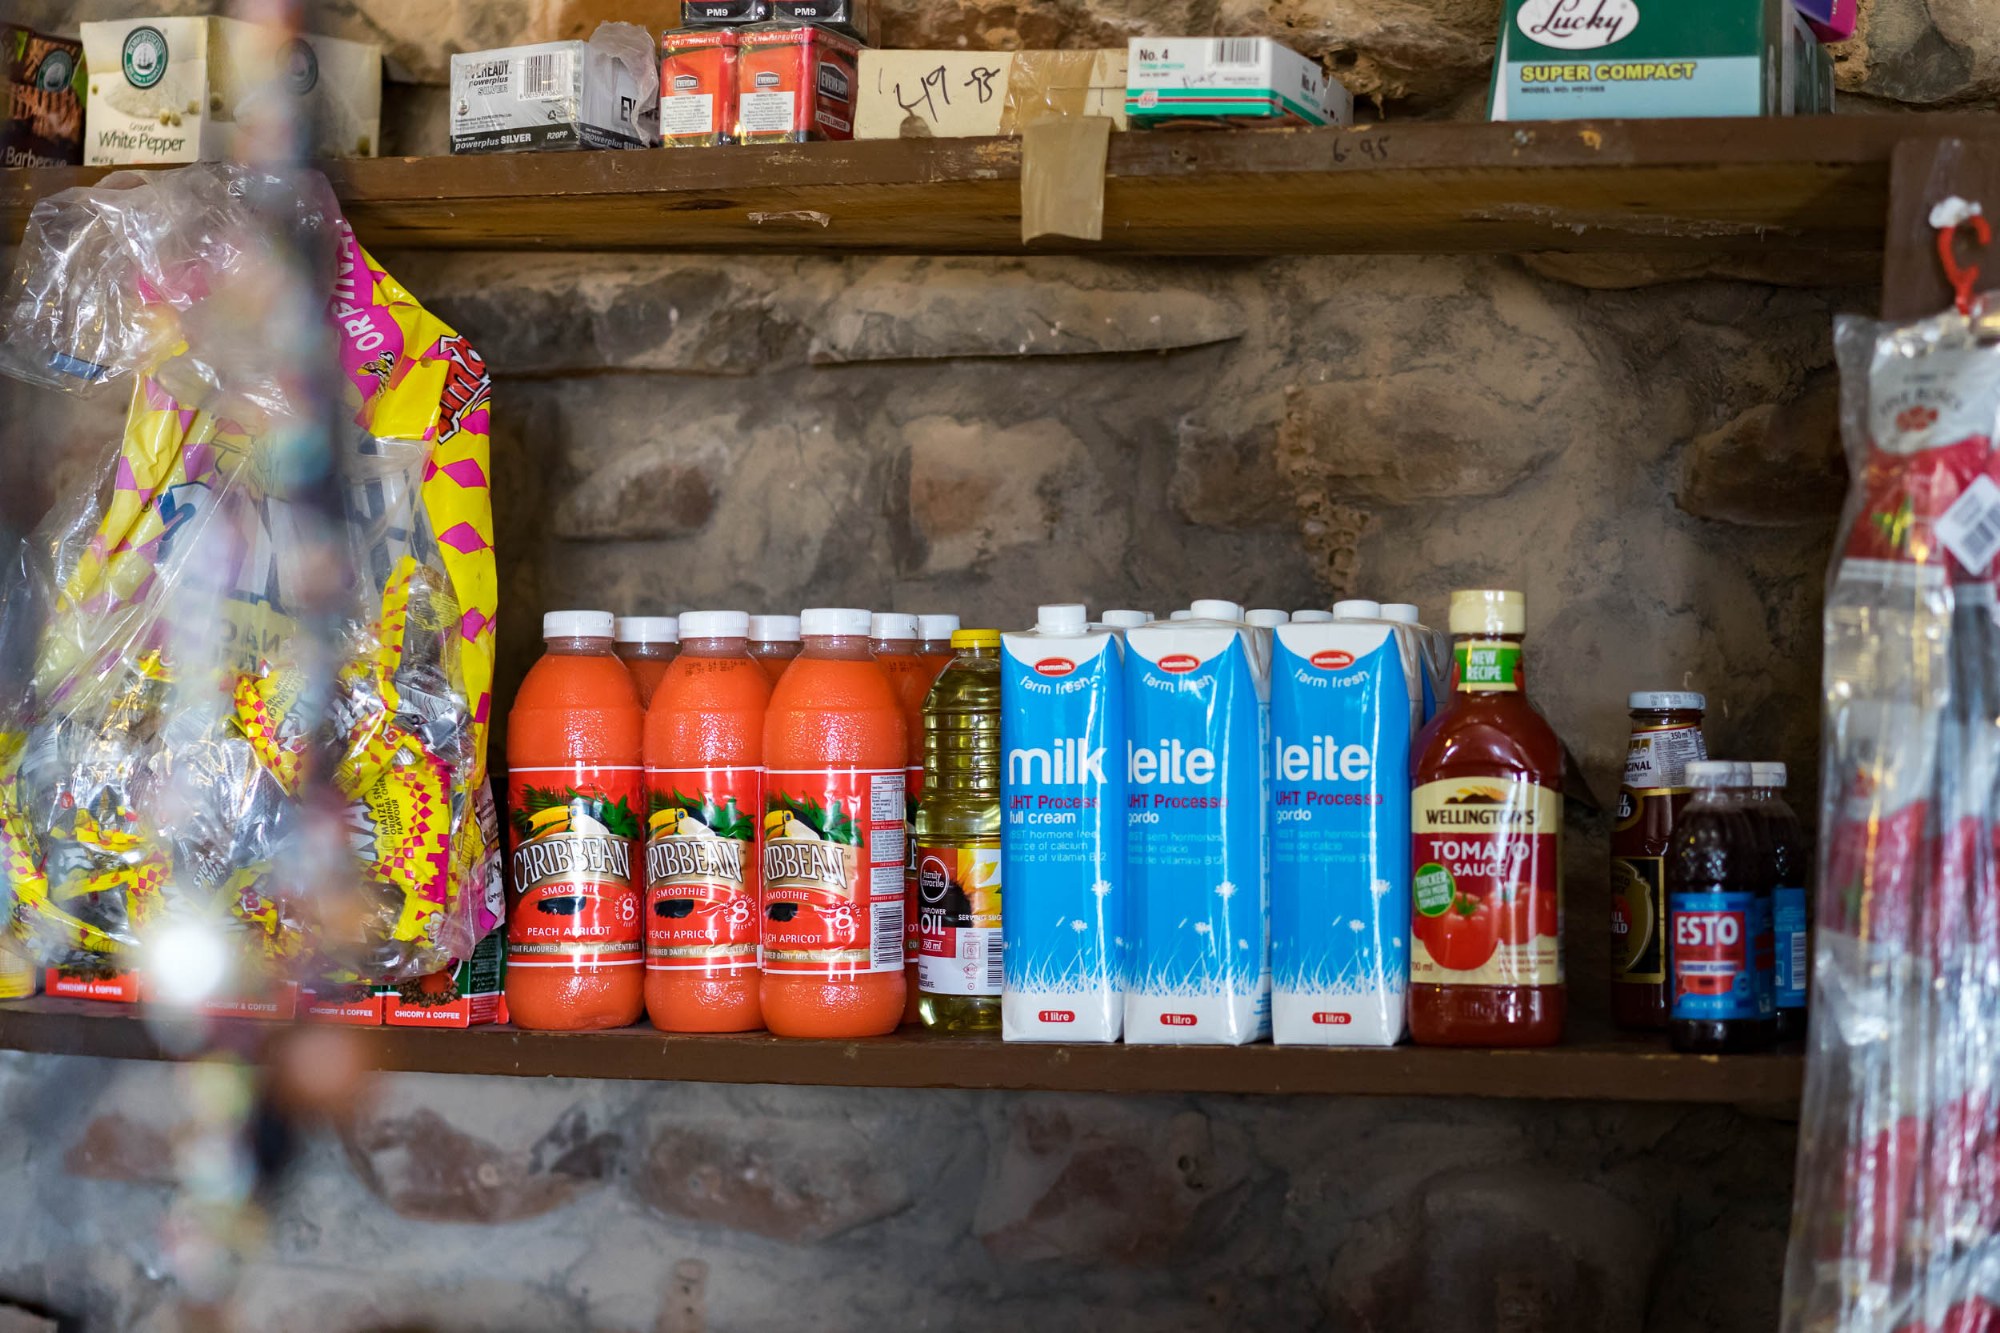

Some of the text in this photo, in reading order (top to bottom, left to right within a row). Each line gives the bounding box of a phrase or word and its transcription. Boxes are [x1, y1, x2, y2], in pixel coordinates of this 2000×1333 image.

[706, 8, 729, 17] PM9
[794, 7, 817, 16] PM9
[1530, 0, 1624, 43] Lucky
[1139, 49, 1169, 61] No. 4
[1520, 62, 1698, 82] SUPER COMPACT
[99, 131, 186, 156] White Pepper
[454, 138, 500, 152] powerplus
[500, 132, 532, 145] SILVER
[1019, 674, 1092, 695] farm fresh
[1142, 672, 1176, 694] farm
[1294, 668, 1371, 689] farm fresh
[1008, 737, 1109, 785] milk
[1127, 738, 1217, 785] leite
[1275, 734, 1371, 782] leite
[376, 802, 390, 836] MAIZE
[383, 797, 397, 835] ORIGINAL
[391, 799, 404, 835] FLAVOUR
[1009, 811, 1077, 825] full cream
[1127, 811, 1160, 827] gordo
[1276, 808, 1312, 824] gordo
[1029, 830, 1074, 840] hormone
[1037, 841, 1049, 851] of
[1050, 841, 1089, 851] calcium
[1429, 840, 1531, 860] TOMATO
[513, 837, 632, 894] CARIBBEAN
[1037, 852, 1049, 863] of
[1050, 852, 1087, 862] vitamin
[1452, 863, 1508, 877] SAUCE
[656, 887, 706, 899] SMOOTHIE
[766, 890, 809, 901] SMOOTHIE
[622, 898, 635, 921] 8
[732, 900, 749, 924] 8
[835, 905, 851, 930] 8
[527, 927, 560, 937] PEACH
[920, 913, 947, 936] OIL
[1675, 914, 1739, 946] ESTO
[779, 933, 822, 944] APRICOT
[922, 941, 942, 950] 750 ml
[523, 944, 558, 954] FLAVOURED
[56, 982, 88, 993] CHICORY
[95, 984, 123, 996] COFFEE
[248, 1002, 278, 1012] COFFEE
[309, 1006, 339, 1016] CHICORY
[346, 1008, 374, 1017] COFFEE
[394, 1009, 425, 1019] CHICORY
[433, 1011, 461, 1020] COFFEE
[1051, 1010, 1070, 1022] litre
[1173, 1013, 1192, 1025] litro
[1326, 1011, 1346, 1025] litro
